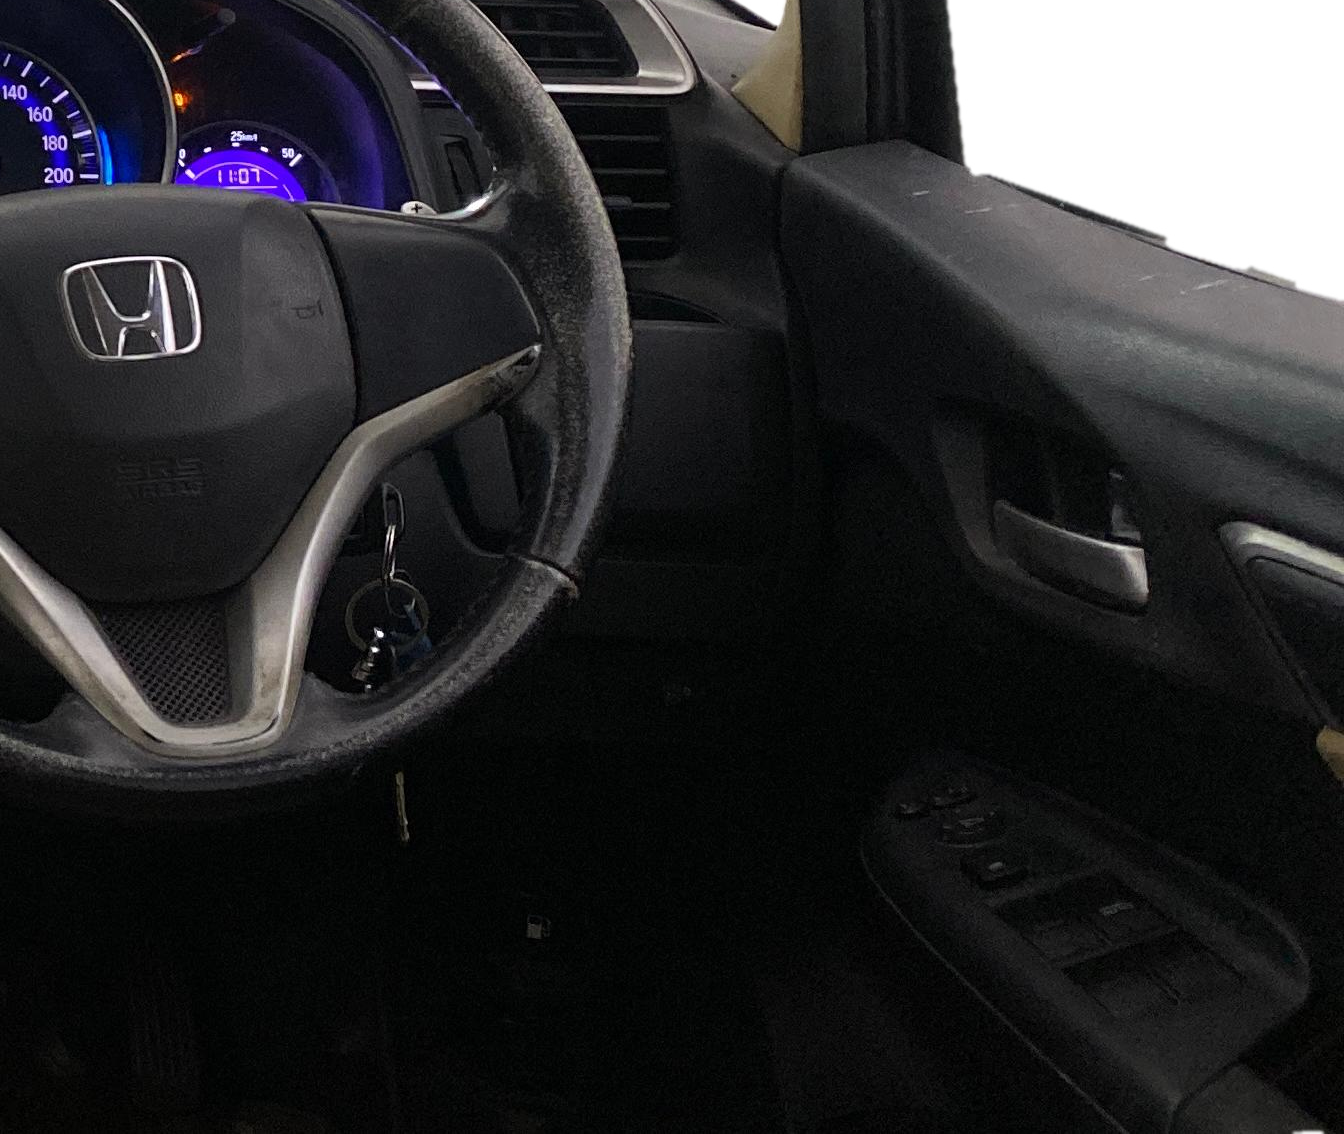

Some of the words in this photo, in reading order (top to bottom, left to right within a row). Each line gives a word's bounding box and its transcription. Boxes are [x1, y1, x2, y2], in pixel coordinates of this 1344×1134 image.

[3, 85, 28, 101] 140
[28, 106, 53, 123] 160
[43, 135, 68, 152] 180
[179, 148, 186, 160] 0
[281, 147, 295, 159] 50
[44, 167, 74, 184] 200
[217, 168, 261, 184] 11:07
